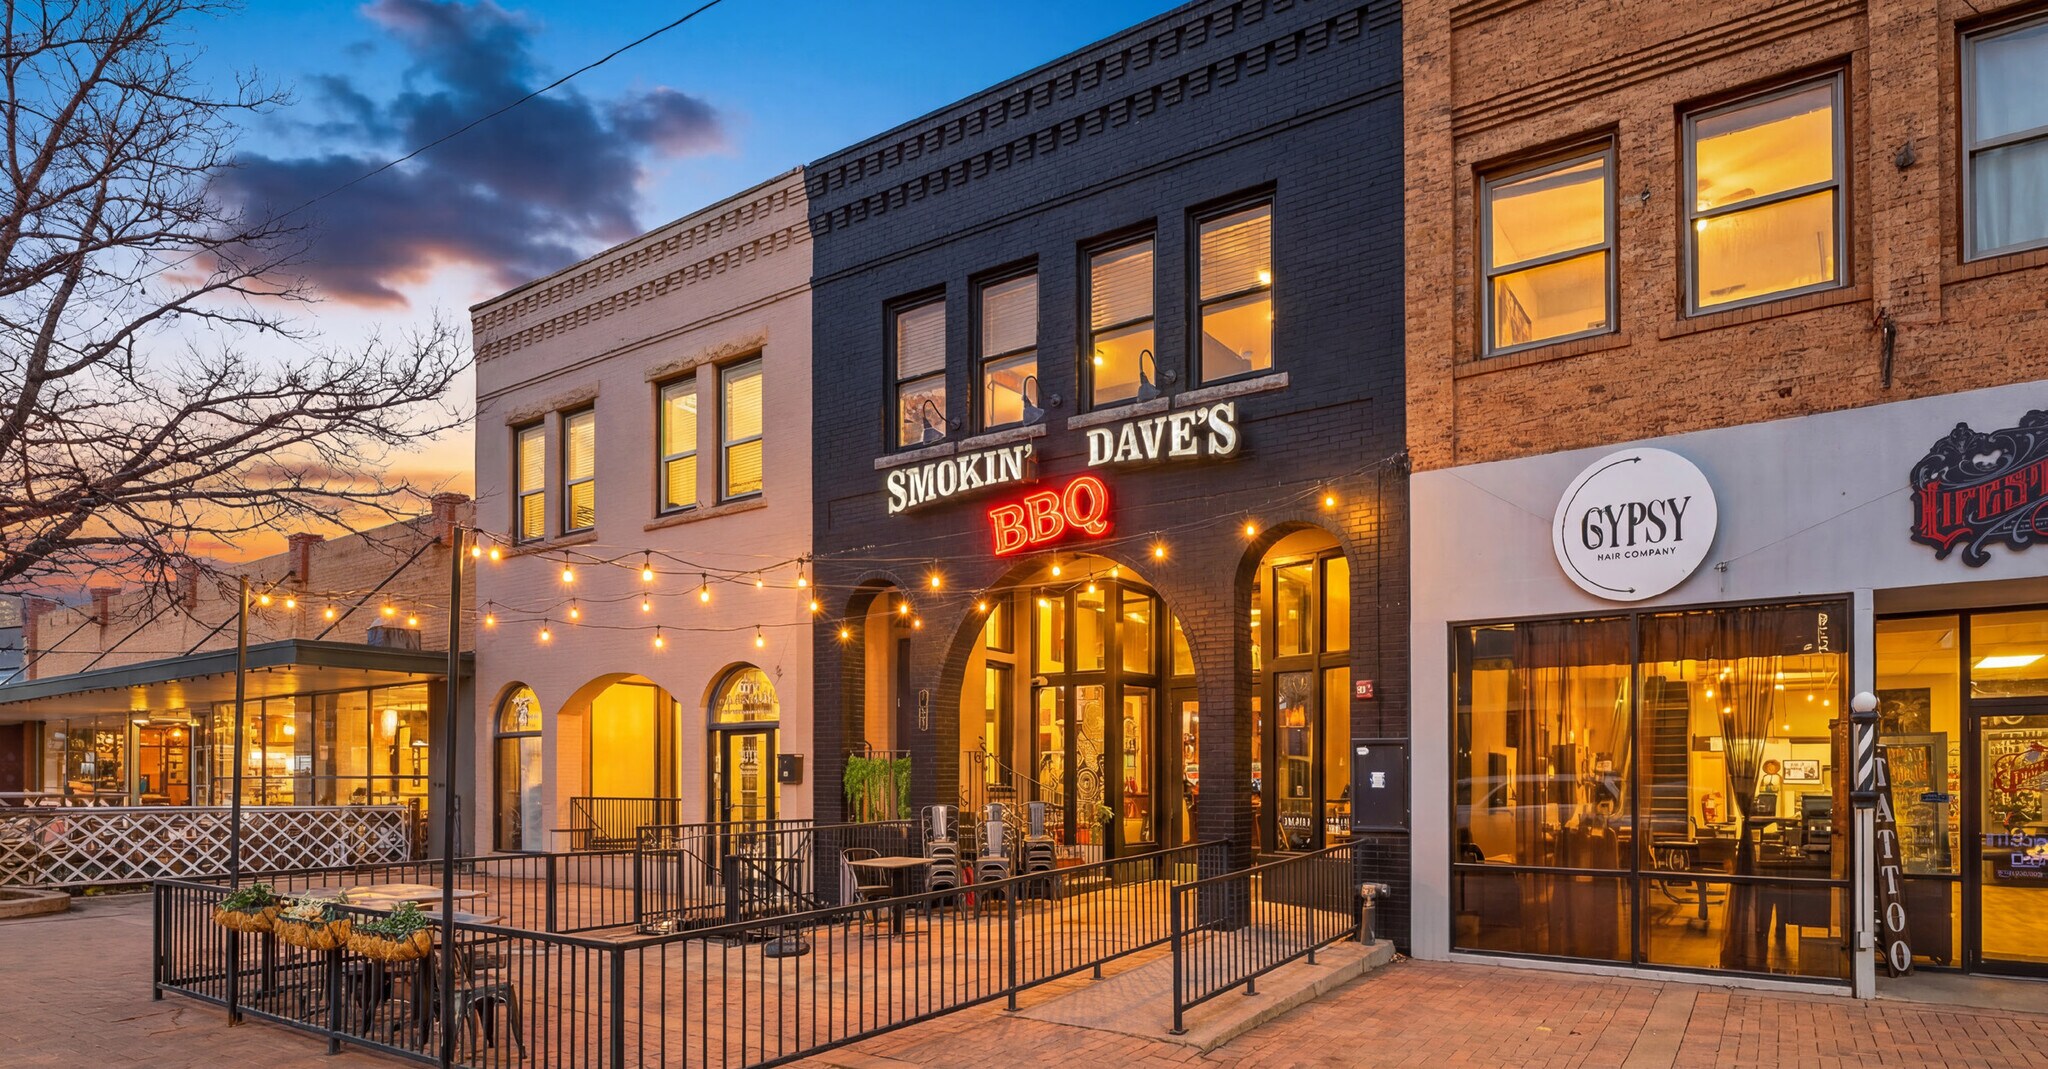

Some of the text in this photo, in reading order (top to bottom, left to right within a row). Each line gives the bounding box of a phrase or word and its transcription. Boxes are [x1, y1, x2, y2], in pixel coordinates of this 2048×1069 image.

[887, 402, 1237, 515] SMOKIN' DAVE'S
[989, 476, 1109, 557] BBQ
[1581, 496, 1692, 550] GYPSY
[1597, 546, 1677, 562] HAIR COMPANY
[1875, 757, 1911, 972] TATTOO
